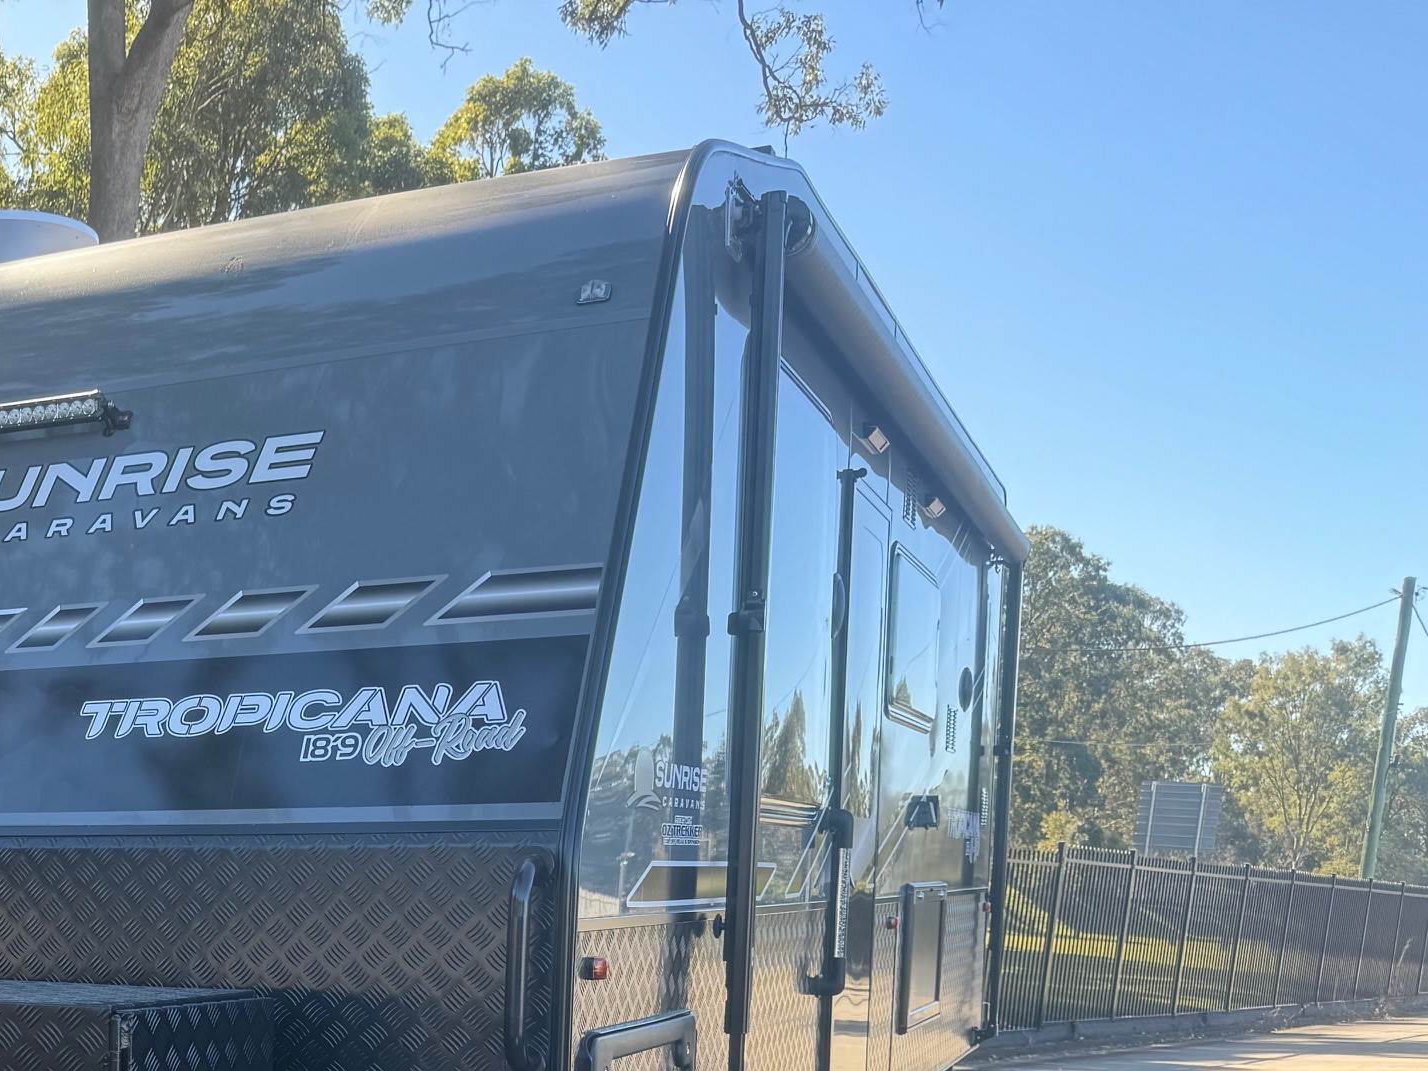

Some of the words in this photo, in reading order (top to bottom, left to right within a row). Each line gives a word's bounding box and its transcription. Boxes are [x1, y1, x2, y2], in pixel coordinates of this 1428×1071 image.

[79, 680, 508, 739] TROPICANA
[363, 708, 527, 767] Off-Road
[654, 760, 708, 793] SUNRISE
[662, 796, 706, 811] CARAVANS
